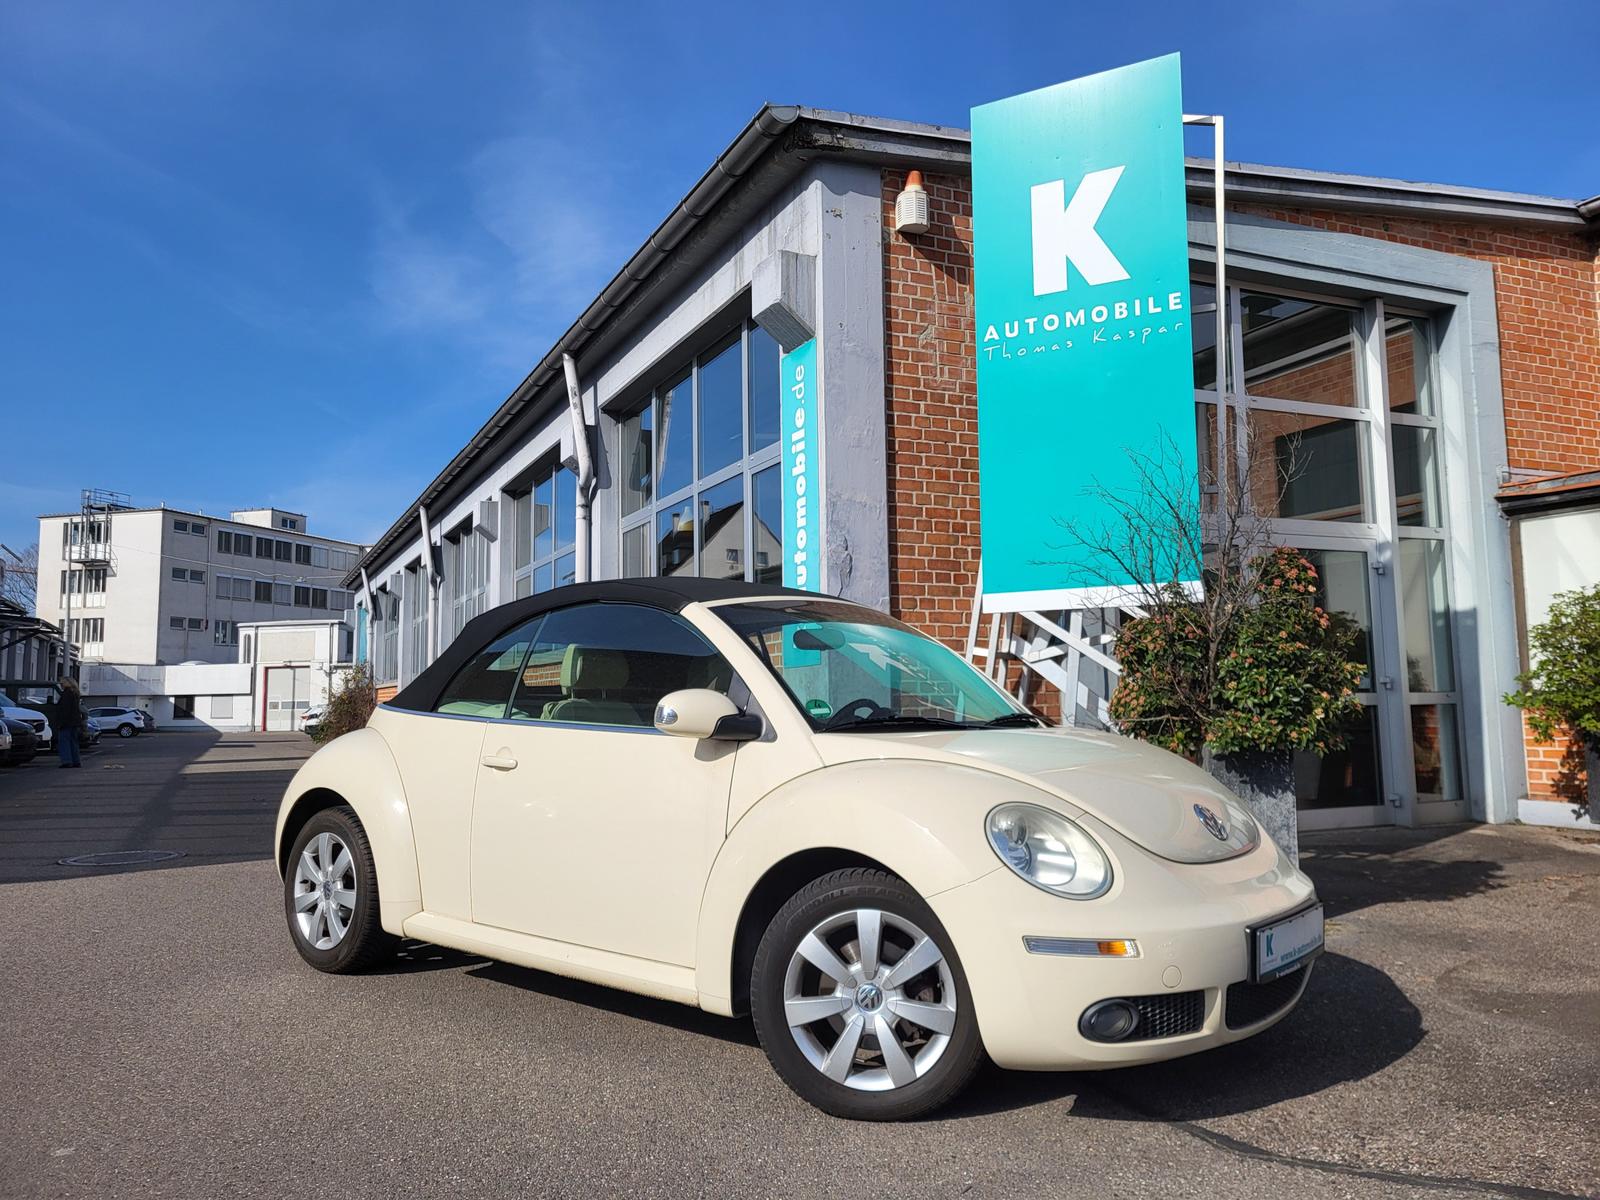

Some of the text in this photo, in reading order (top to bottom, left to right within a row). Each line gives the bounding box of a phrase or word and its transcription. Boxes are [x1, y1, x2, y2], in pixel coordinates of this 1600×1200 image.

[1030, 165, 1131, 296] K
[983, 291, 1184, 343] AUTOMOBILE
[983, 322, 1185, 361] Thomas Kaspar
[791, 364, 807, 590] utomobile.de
[1266, 932, 1274, 958] K
